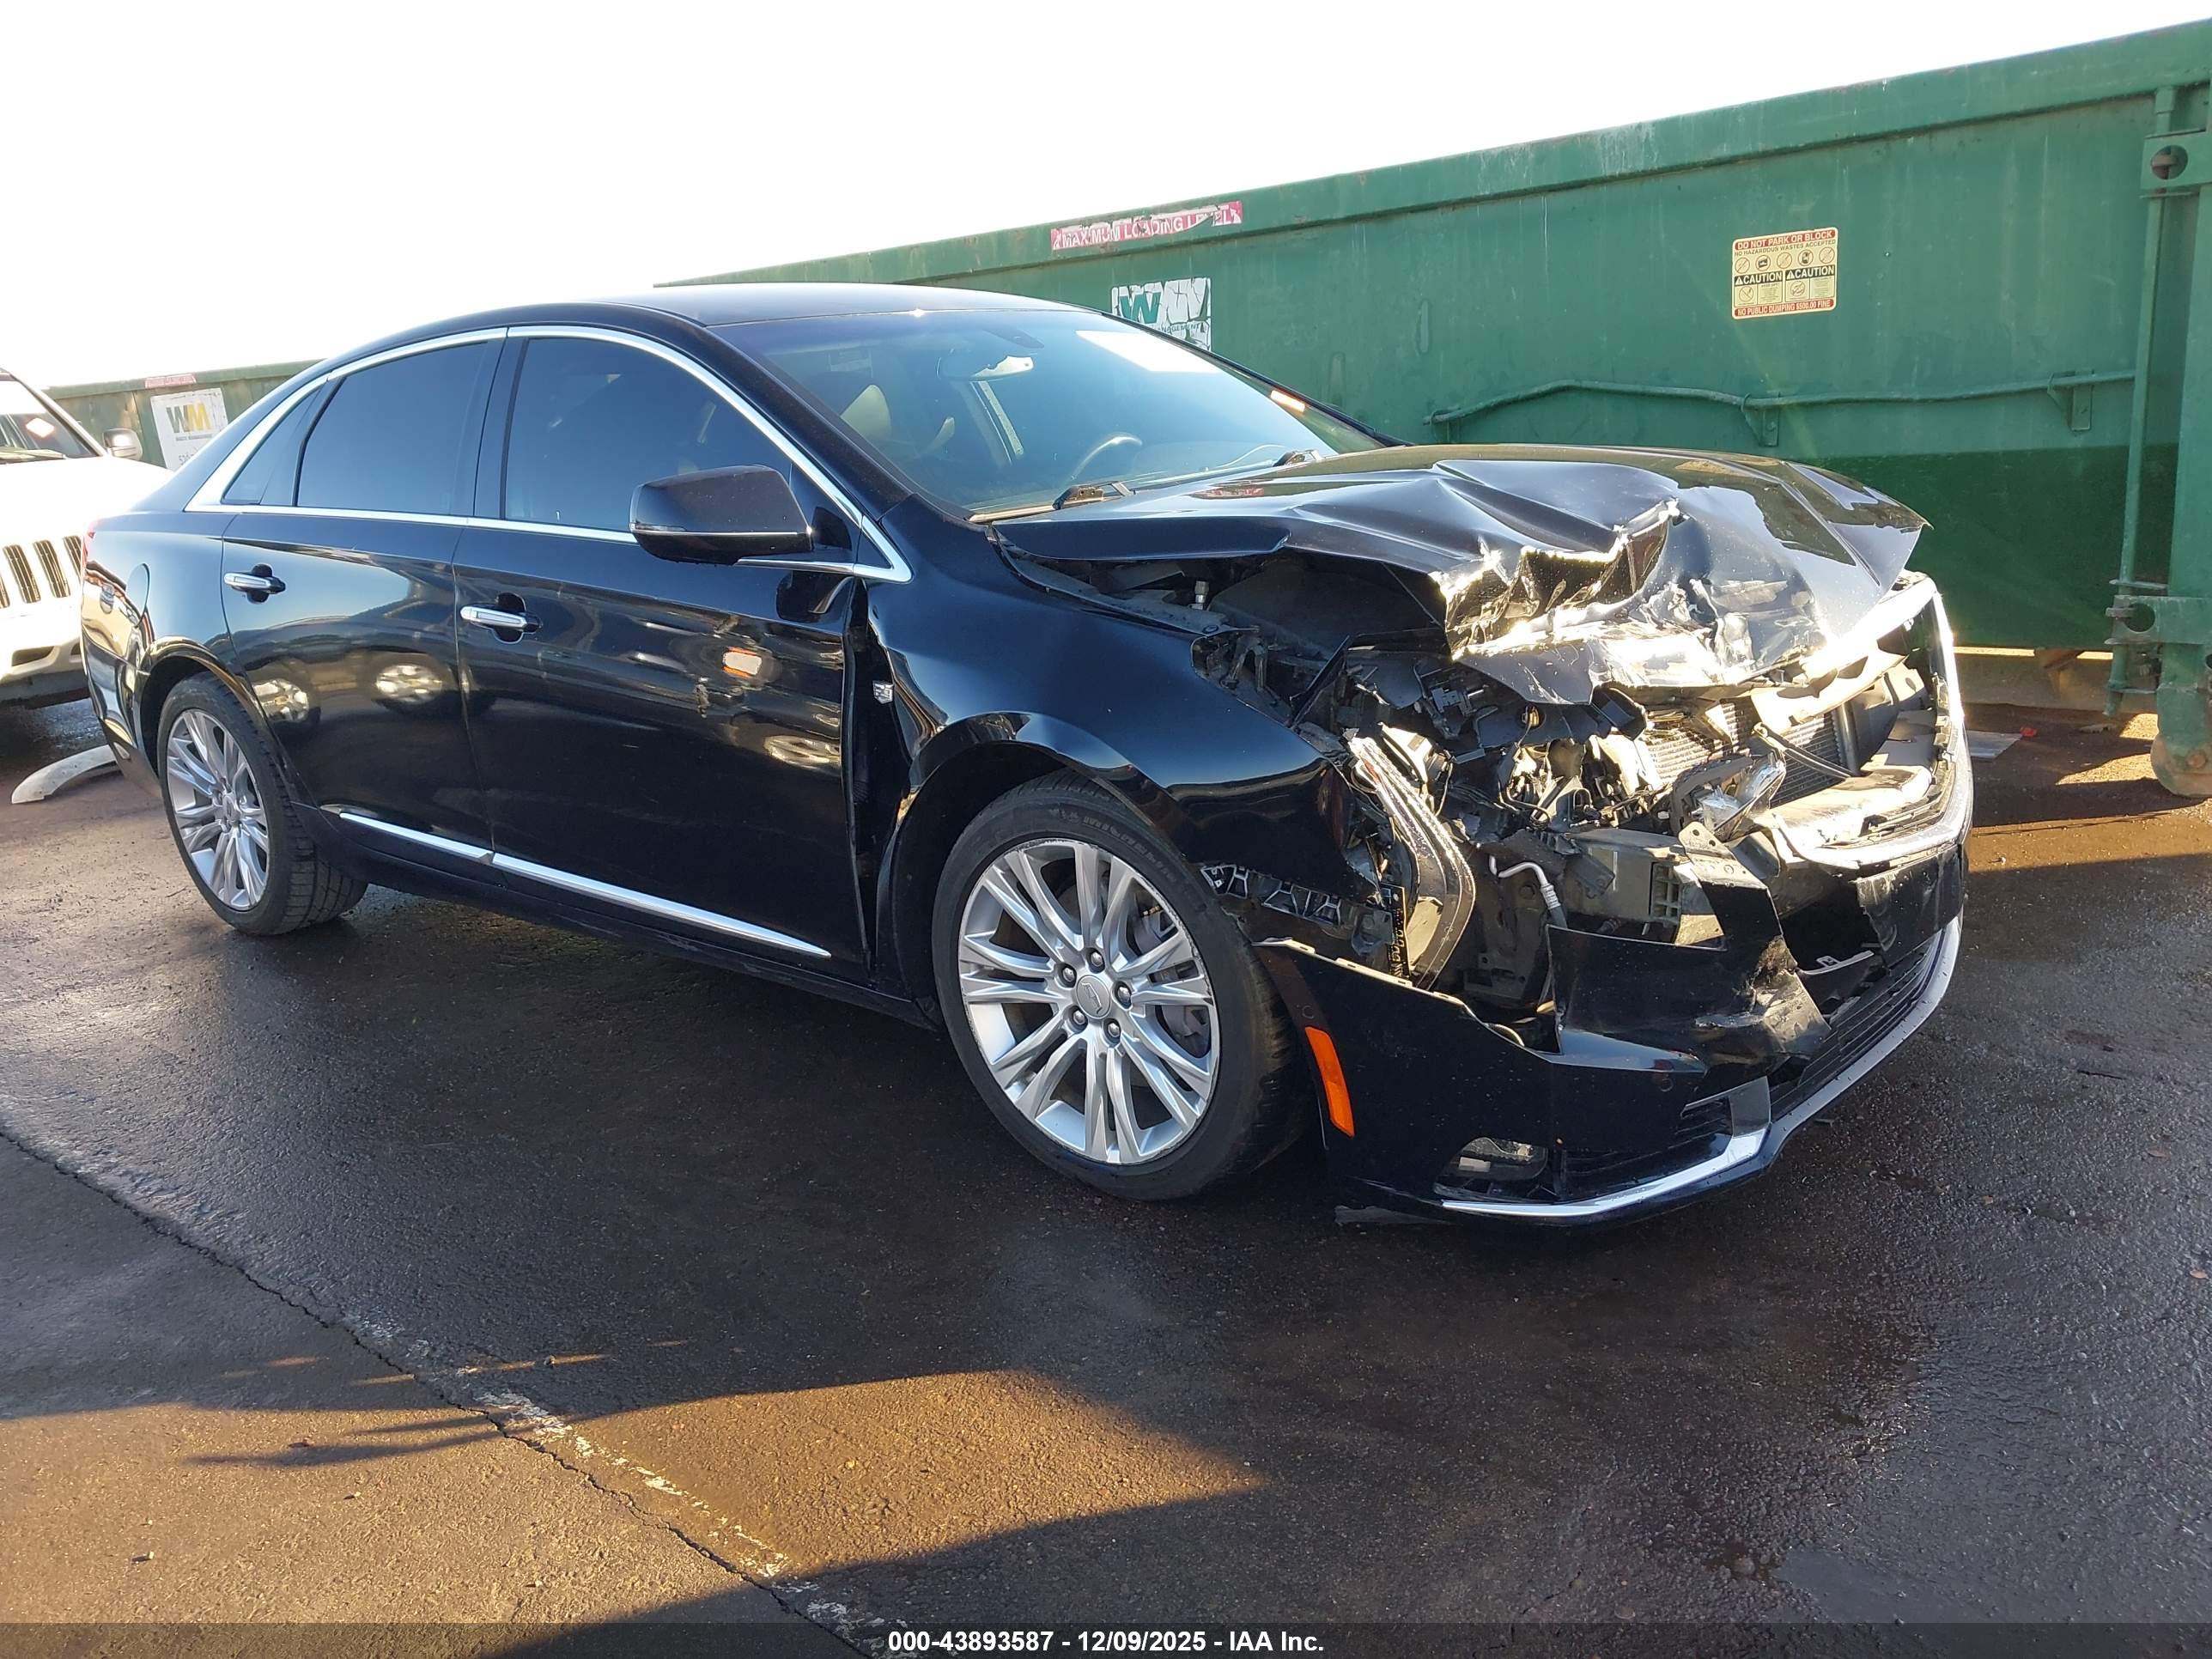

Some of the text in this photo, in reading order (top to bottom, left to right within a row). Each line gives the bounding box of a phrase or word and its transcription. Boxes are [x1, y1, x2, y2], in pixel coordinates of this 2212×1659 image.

[1124, 216, 1184, 240] LOADING
[1737, 230, 1833, 250] DO NOT PARK OR BLOCK
[1744, 246, 1779, 256] HAZARDOUS
[1780, 243, 1804, 252] WASTES
[1805, 240, 1836, 248] ACCEPTED
[1743, 271, 1782, 284] CAUTION
[1795, 266, 1834, 279] CAUTION
[1737, 307, 1747, 316] NO
[1747, 305, 1768, 315] PUBLIC
[1769, 302, 1796, 313] DUMPING
[166, 403, 212, 434] WM
